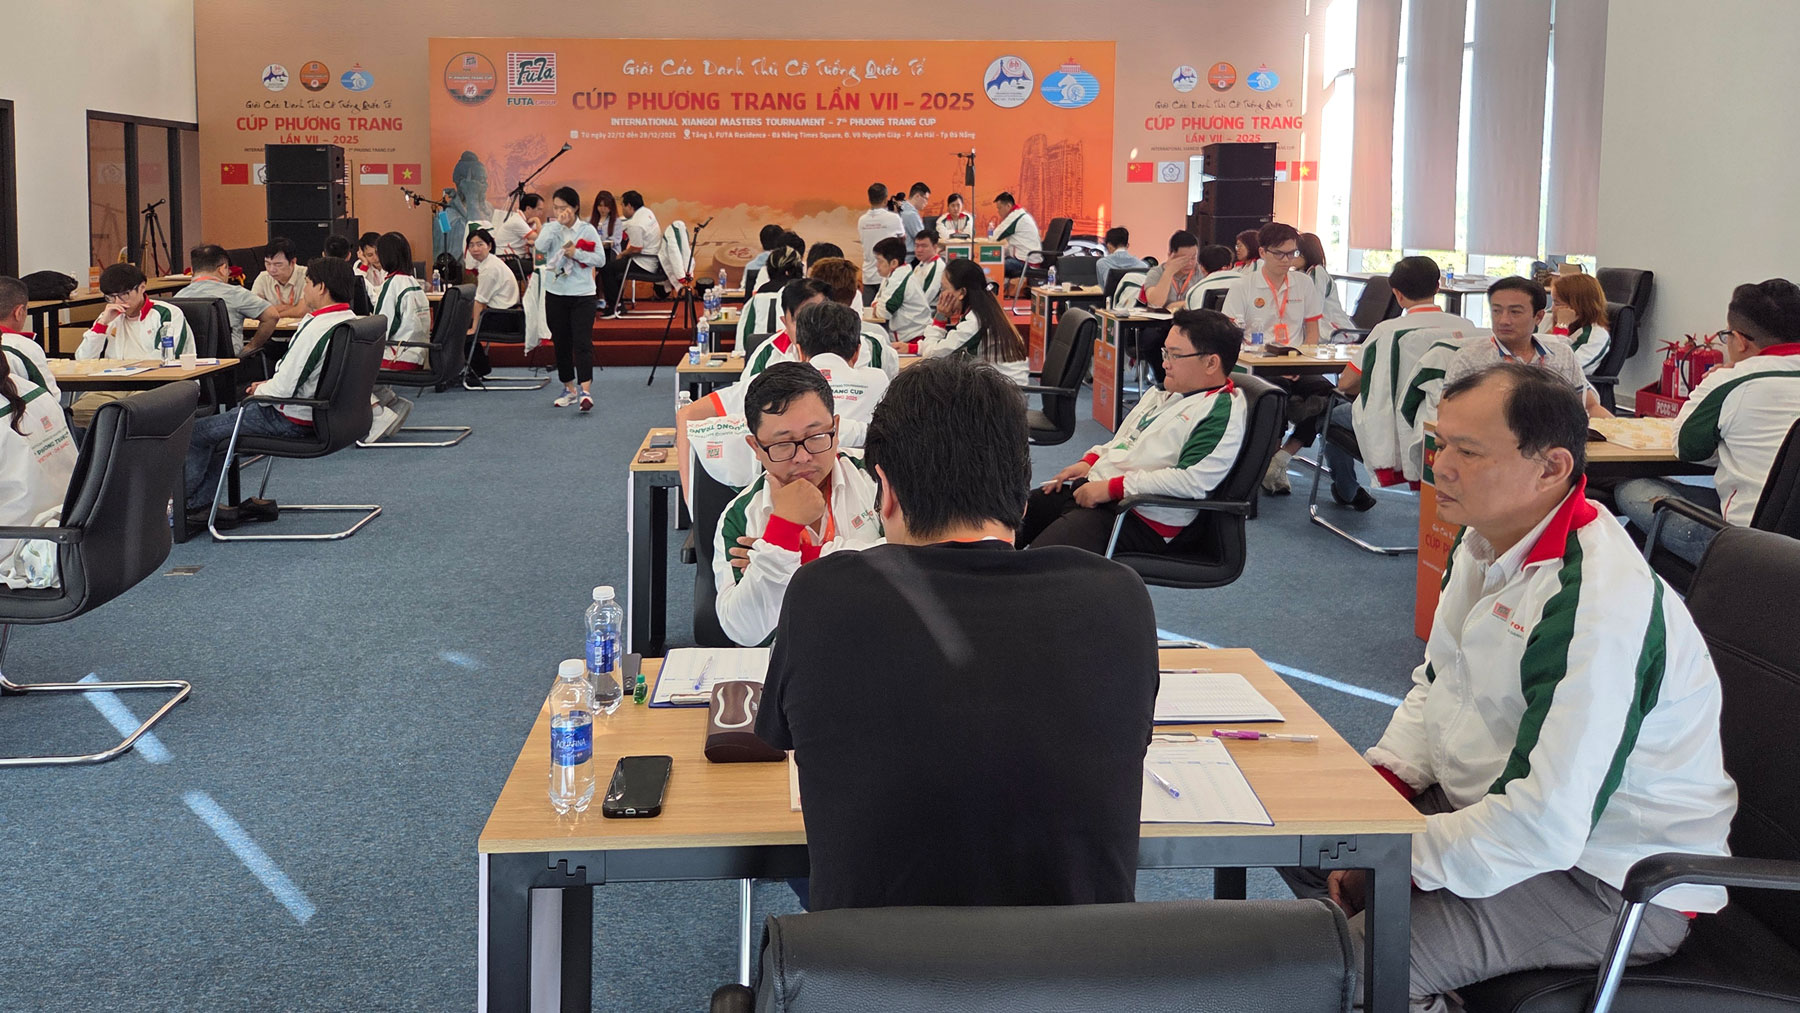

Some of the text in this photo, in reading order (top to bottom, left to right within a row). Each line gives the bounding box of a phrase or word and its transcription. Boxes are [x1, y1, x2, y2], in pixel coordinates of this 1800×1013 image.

[661, 58, 695, 76] Các
[702, 56, 744, 76] Danh
[507, 98, 534, 106] FUTA
[572, 87, 617, 110] CÚP
[627, 90, 720, 110] PHƯƠNG
[731, 92, 807, 110] TRANG
[816, 87, 860, 110] LẦN
[870, 92, 898, 110] VII
[919, 92, 975, 110] 2025
[236, 114, 403, 131] CÚP PHƯƠNG TRANG
[611, 117, 678, 127] INTERNATIONAL
[682, 117, 717, 127] XIANGQI
[720, 117, 762, 127] MASTERS
[765, 117, 825, 127] TOURNAMENT
[849, 117, 885, 127] PHUONG
[887, 117, 916, 127] TRANG
[919, 117, 937, 127] CUP
[1145, 114, 1303, 131] CÚP PHƯƠNG TRANG
[305, 135, 319, 144] VII
[333, 135, 359, 144] 2025
[1209, 134, 1222, 143] VII
[1236, 134, 1261, 143] 2025
[556, 737, 586, 749] AQUAFINA
